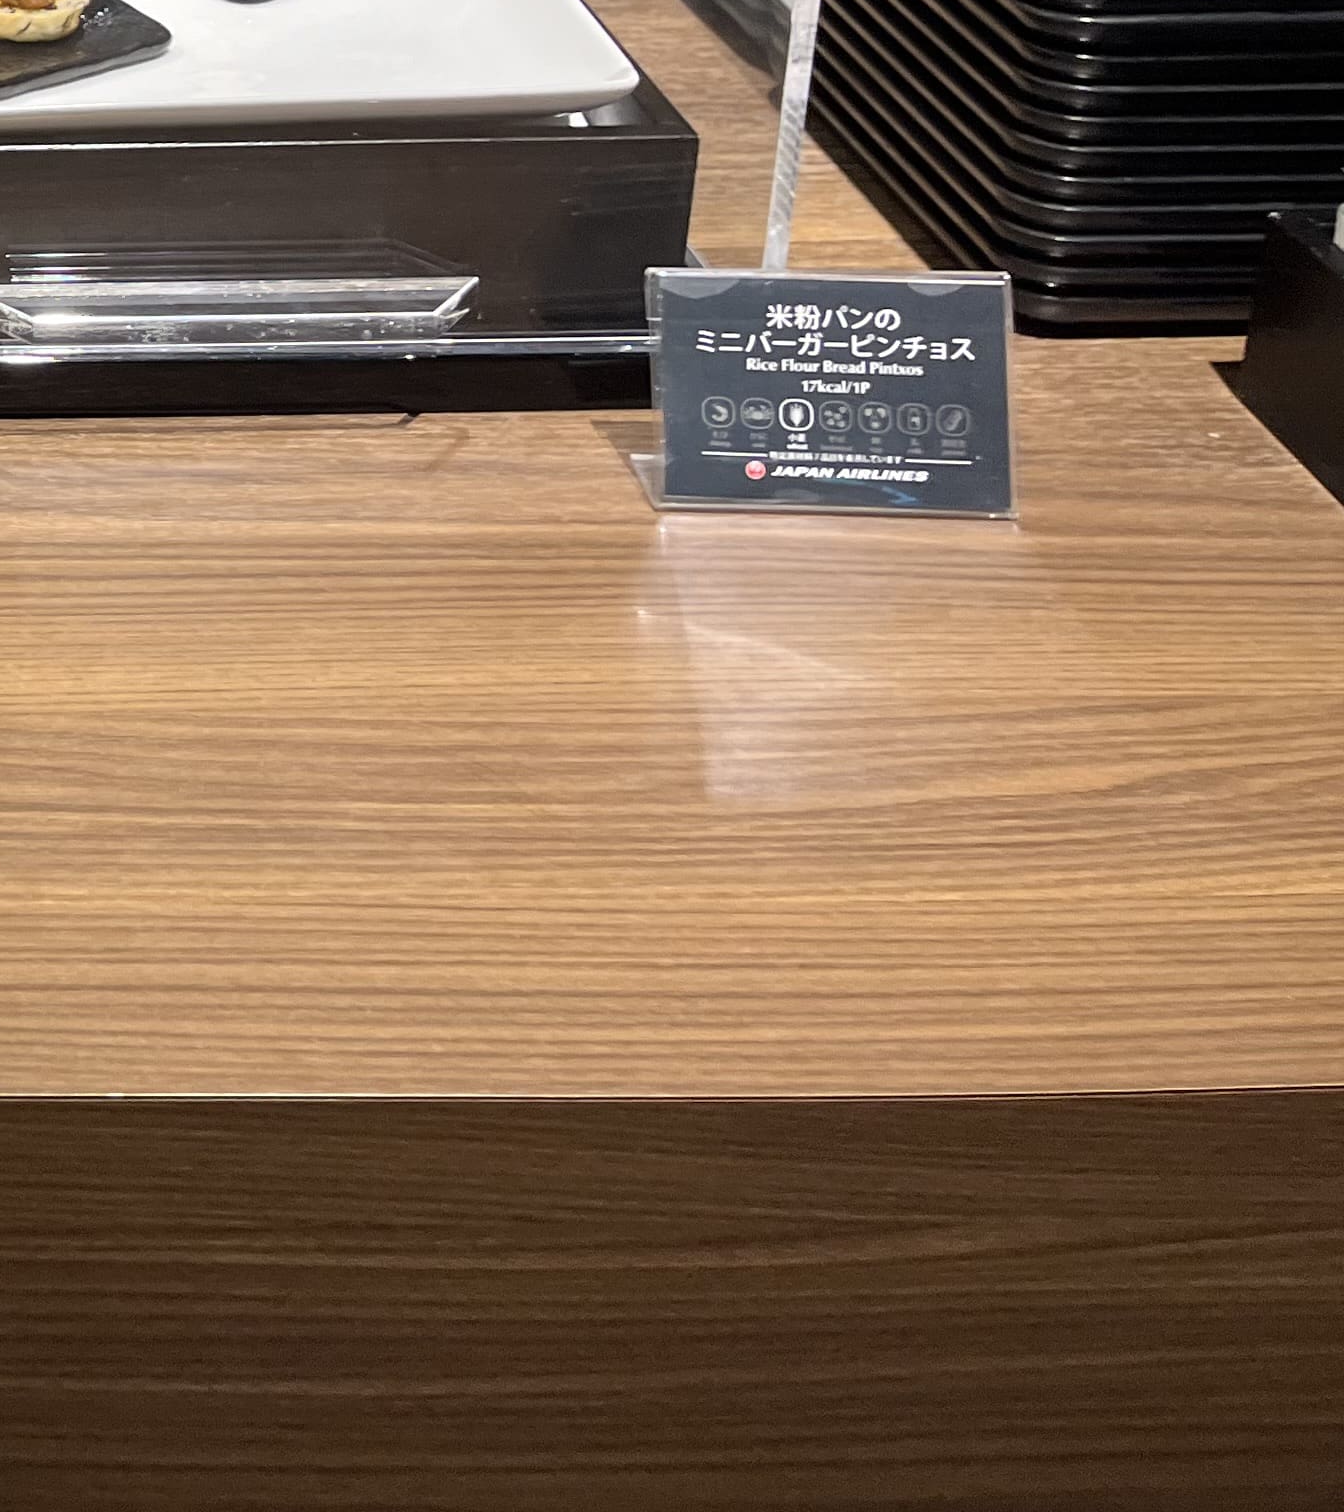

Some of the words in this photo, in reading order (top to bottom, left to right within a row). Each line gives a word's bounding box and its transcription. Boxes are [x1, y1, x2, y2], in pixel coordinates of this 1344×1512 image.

[766, 304, 901, 330] 米粉パンの
[696, 330, 976, 361] ミニバーガーピンチョス
[745, 357, 778, 371] Rice
[781, 358, 820, 373] Flour
[822, 360, 866, 374] Bread
[869, 361, 924, 377] Pintxos
[801, 379, 871, 394] 17kcal/1P
[770, 465, 834, 479] JAPAN
[835, 468, 930, 482] AIRLINES
